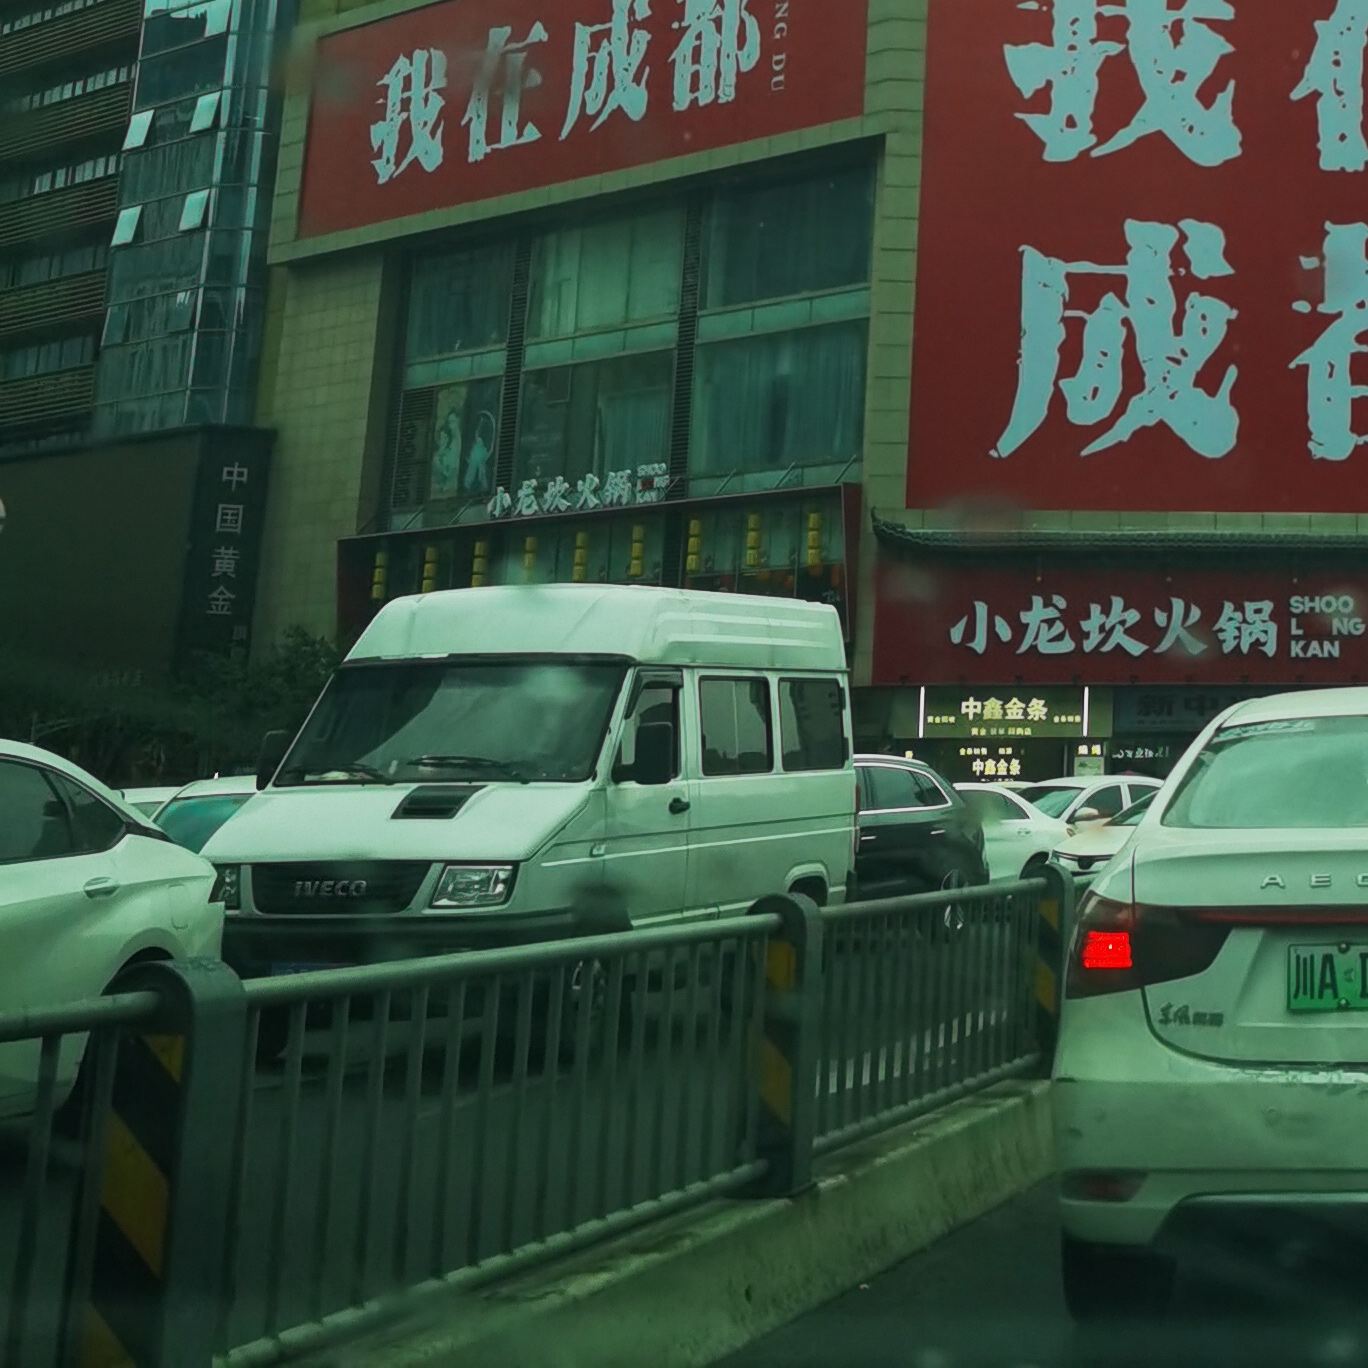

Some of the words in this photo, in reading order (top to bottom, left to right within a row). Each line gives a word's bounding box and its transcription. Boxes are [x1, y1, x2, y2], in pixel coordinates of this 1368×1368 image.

[770, 52, 786, 91] DU
[487, 469, 632, 518] 小龙坎火锅
[206, 461, 248, 615] 中国黄金
[1289, 595, 1355, 614] SHOO
[949, 595, 1278, 658] 小龙坎火锅
[1290, 640, 1340, 658] KAN
[961, 696, 1048, 721] 中鑫金条
[294, 880, 367, 897] IVECO
